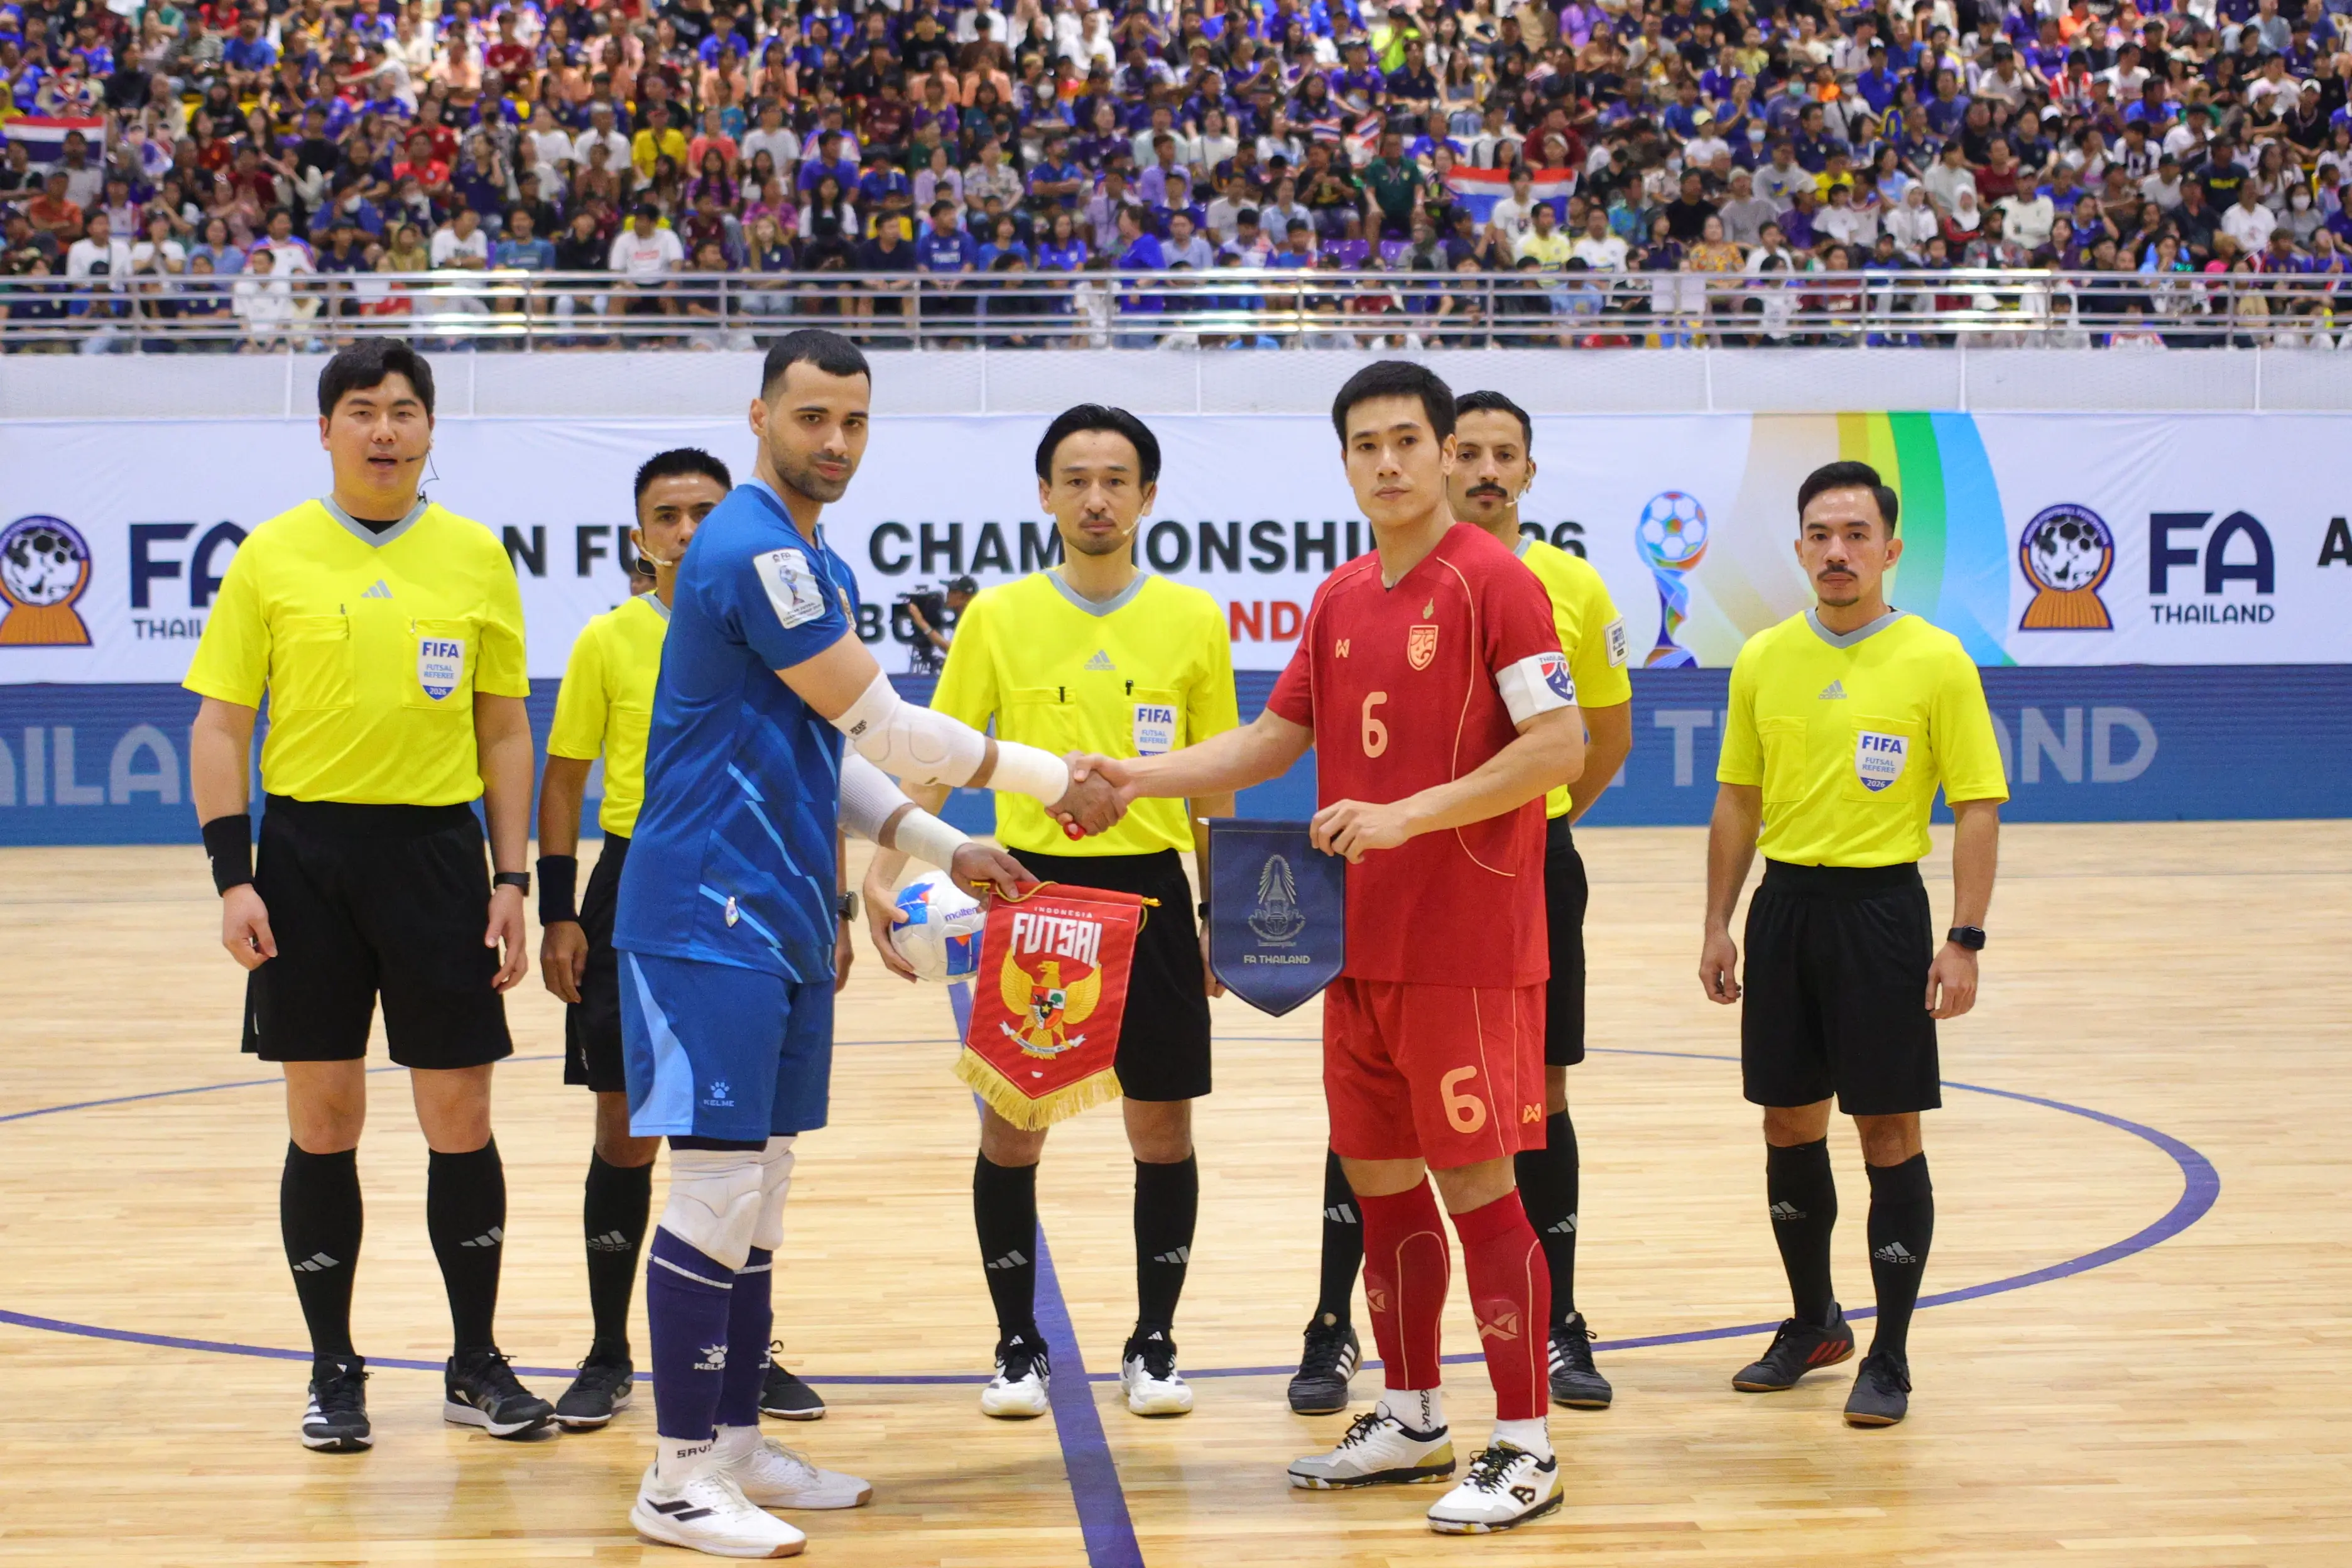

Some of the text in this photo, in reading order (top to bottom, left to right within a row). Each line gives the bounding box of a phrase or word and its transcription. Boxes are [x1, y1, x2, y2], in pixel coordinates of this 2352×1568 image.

[2150, 511, 2274, 594] FA
[130, 521, 249, 607] FA
[2151, 604, 2275, 624] THAILAND
[422, 641, 459, 658] FIFA
[1138, 708, 1172, 723] FIFA
[1361, 692, 1388, 758] 6
[1862, 736, 1902, 754] FIFA
[1862, 764, 1895, 773] REFEREE
[1865, 757, 1895, 766] FUTSAL
[1867, 780, 1885, 788] 2026
[1034, 906, 1094, 918] INDONESIA
[1011, 913, 1102, 969] FUTSAL
[1244, 955, 1310, 964] FA THAILAND
[1440, 1065, 1486, 1133] 6
[1874, 1249, 1916, 1263] adidas
